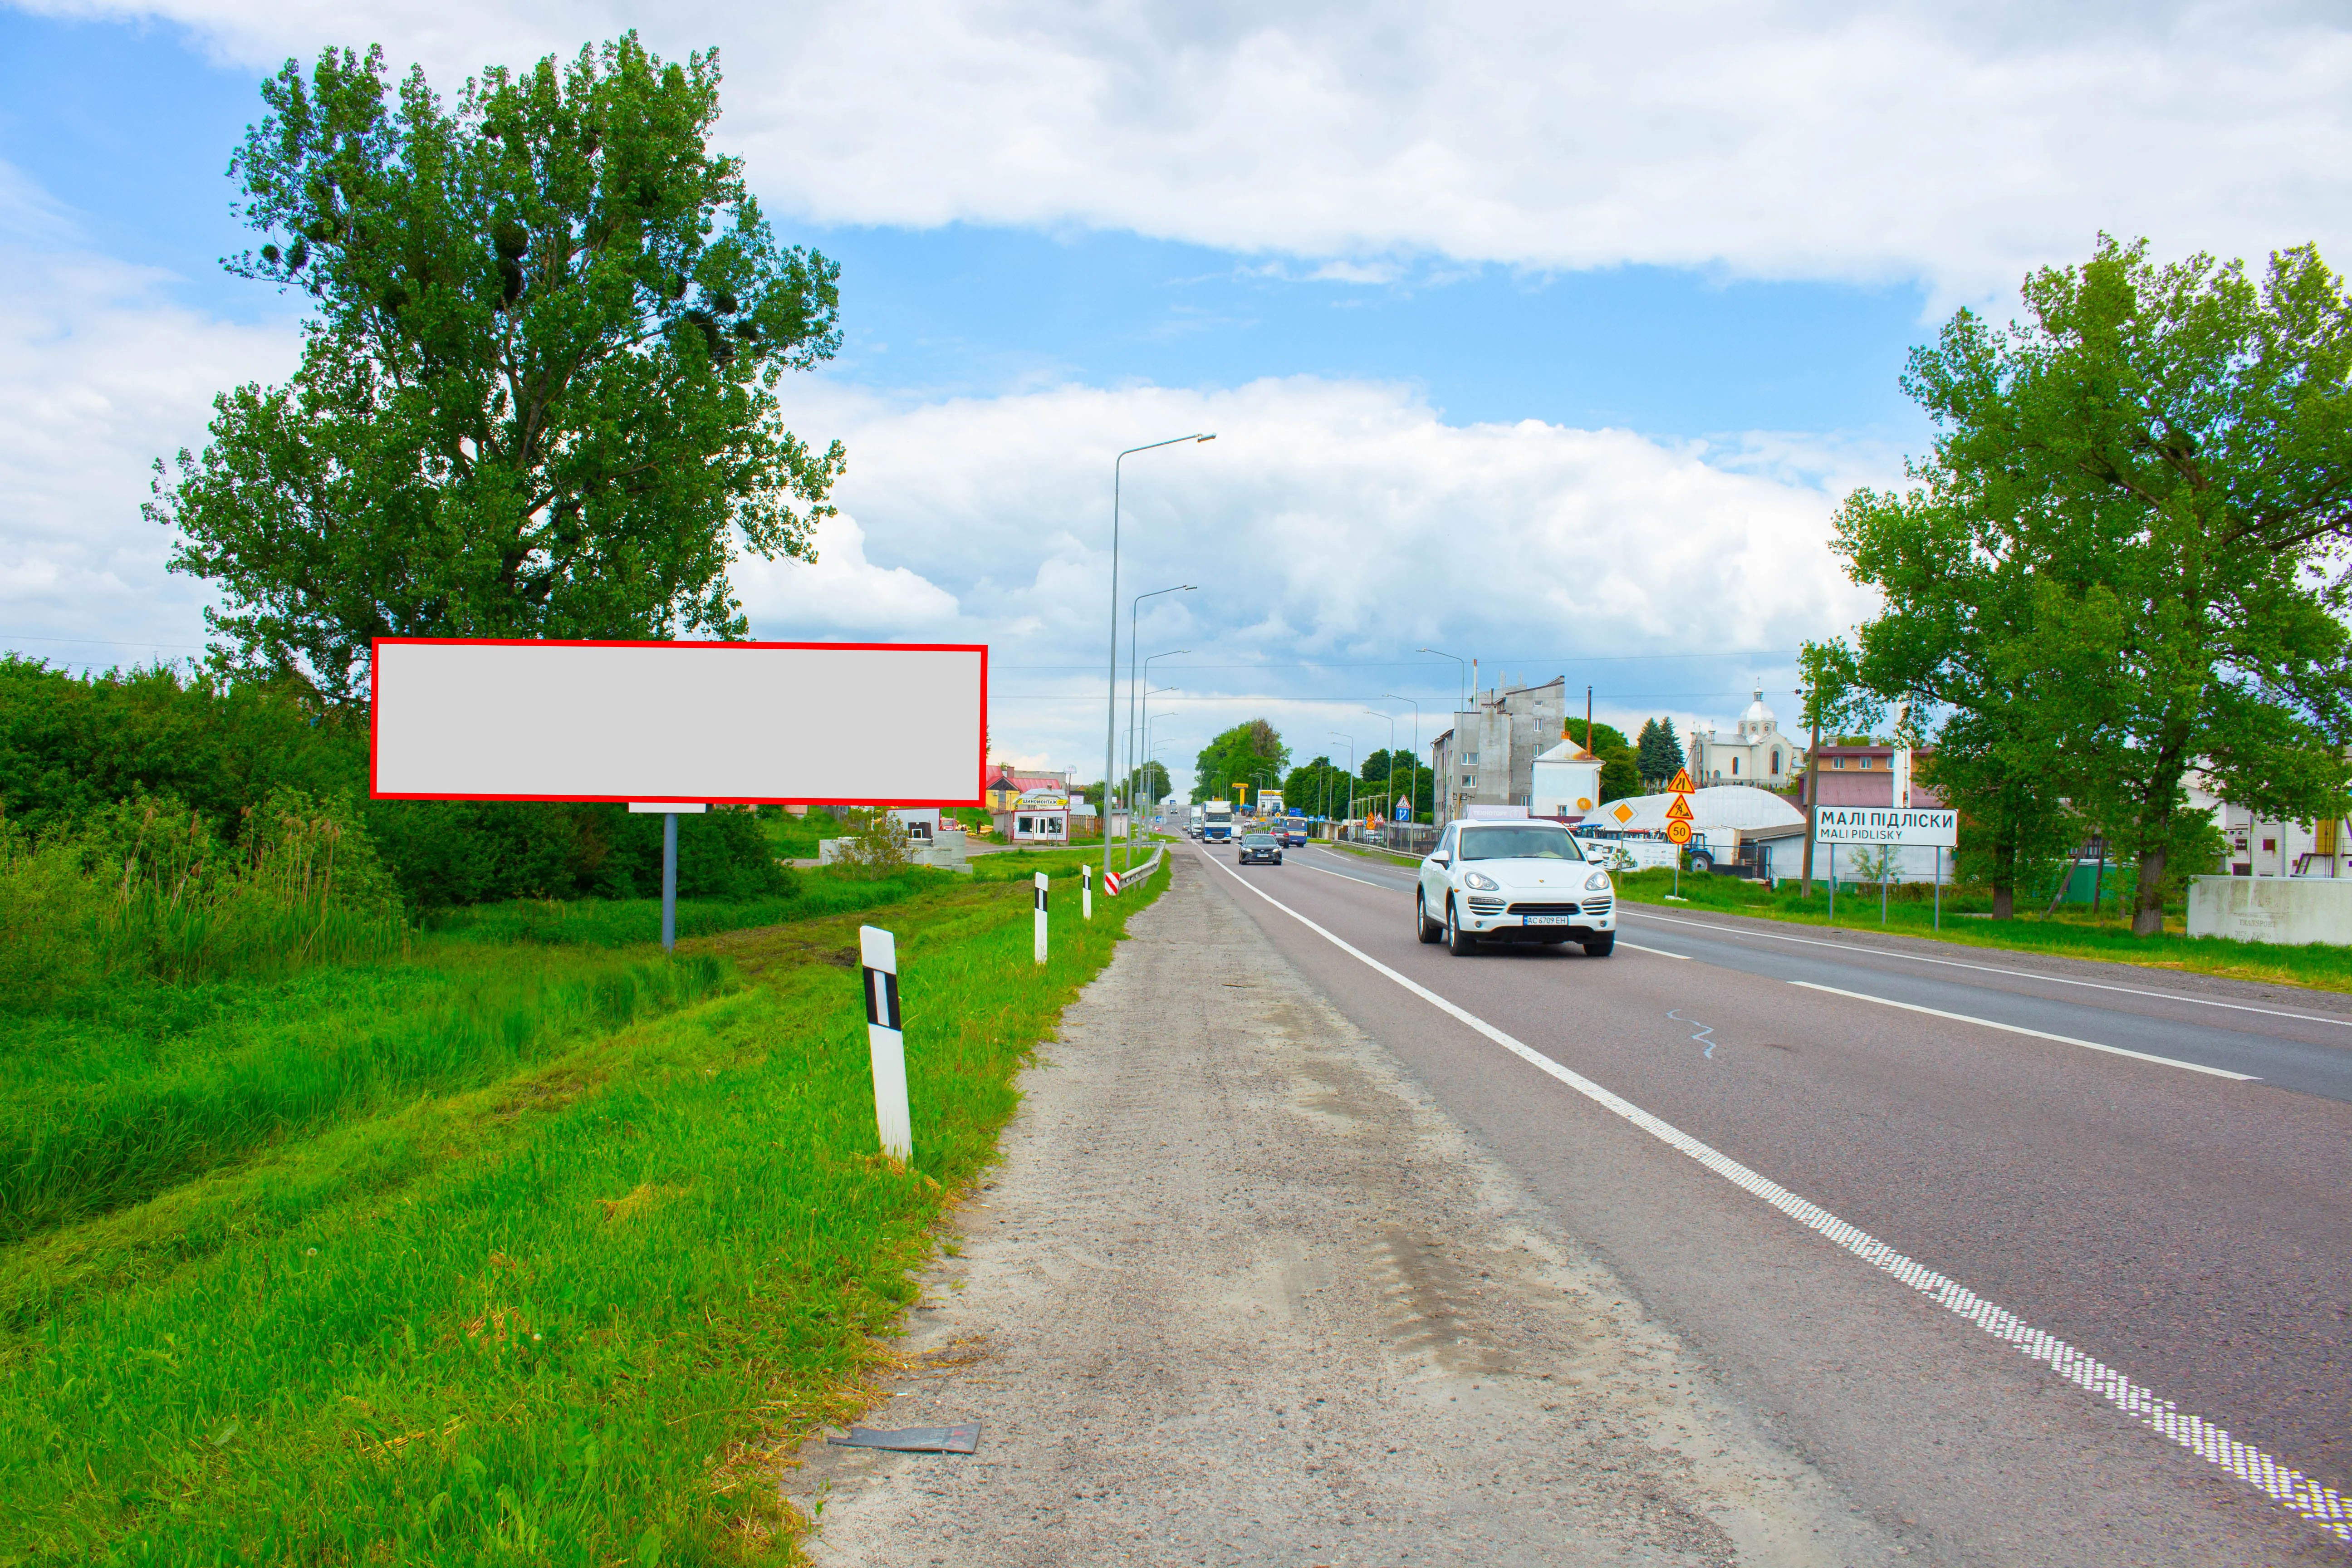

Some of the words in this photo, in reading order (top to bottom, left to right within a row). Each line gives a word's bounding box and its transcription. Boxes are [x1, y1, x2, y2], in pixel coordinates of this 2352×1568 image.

[1821, 811, 1866, 826] МАЛІ
[1871, 813, 1953, 828] ПІДЛІСКИ
[1673, 827, 1686, 836] 50
[1821, 828, 1848, 838] MALI
[1852, 830, 1902, 839] PIDLISKY
[2239, 919, 2276, 928] TRANSPORT
